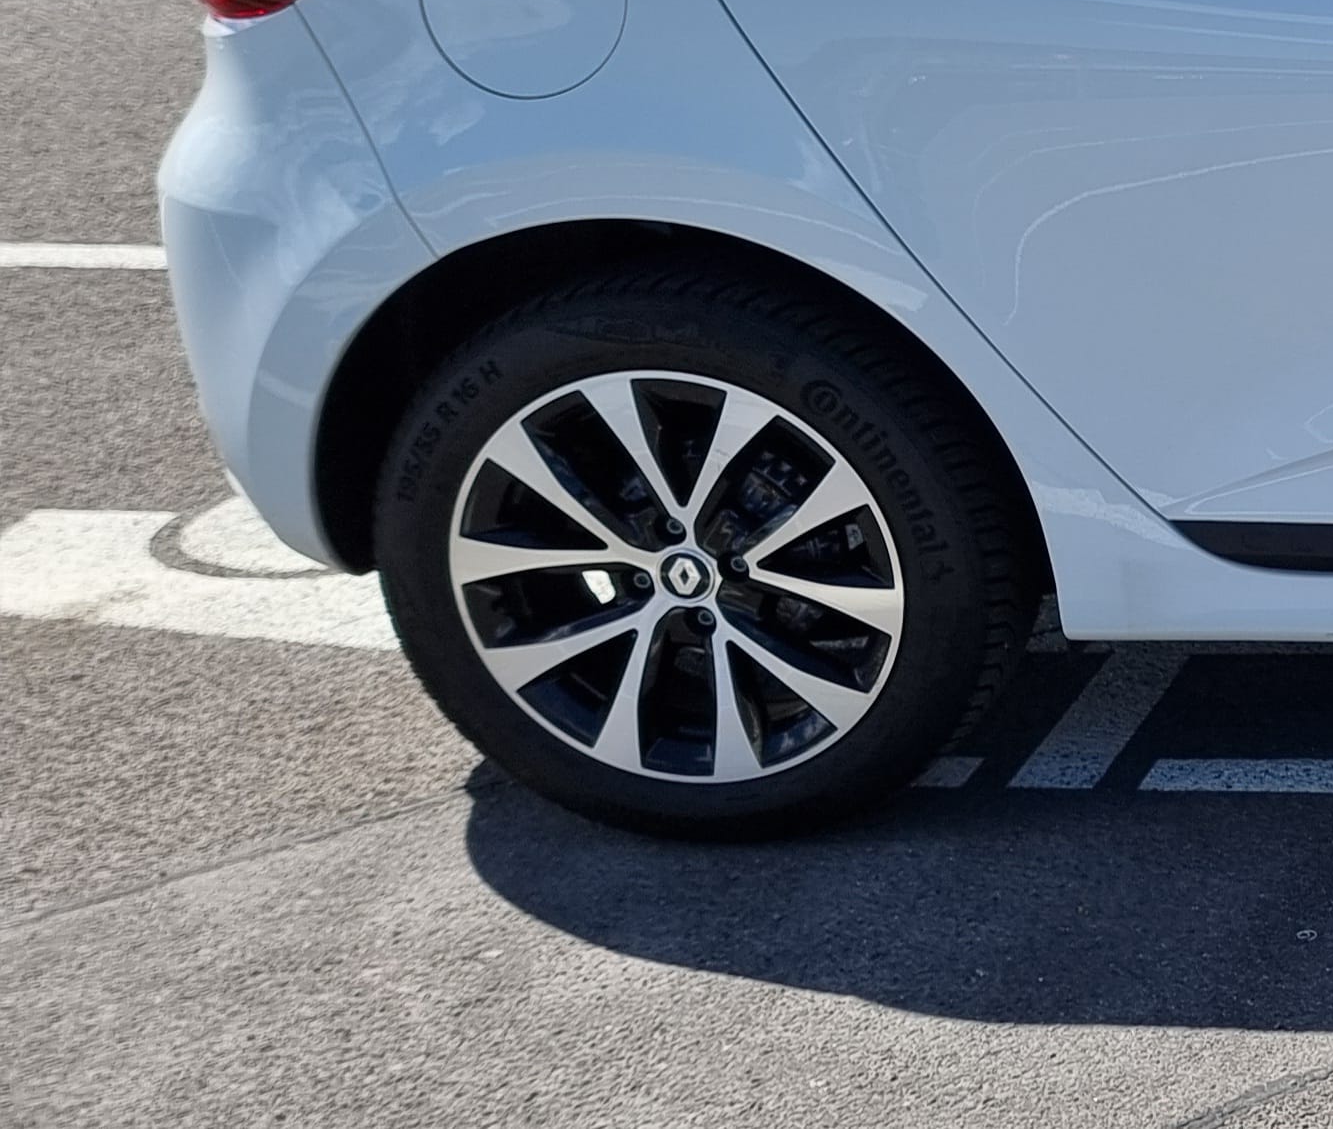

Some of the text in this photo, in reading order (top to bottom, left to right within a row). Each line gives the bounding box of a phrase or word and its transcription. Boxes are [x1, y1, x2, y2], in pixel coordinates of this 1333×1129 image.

[395, 358, 505, 503] 195/55 R 16 H
[801, 378, 950, 557] Continental
